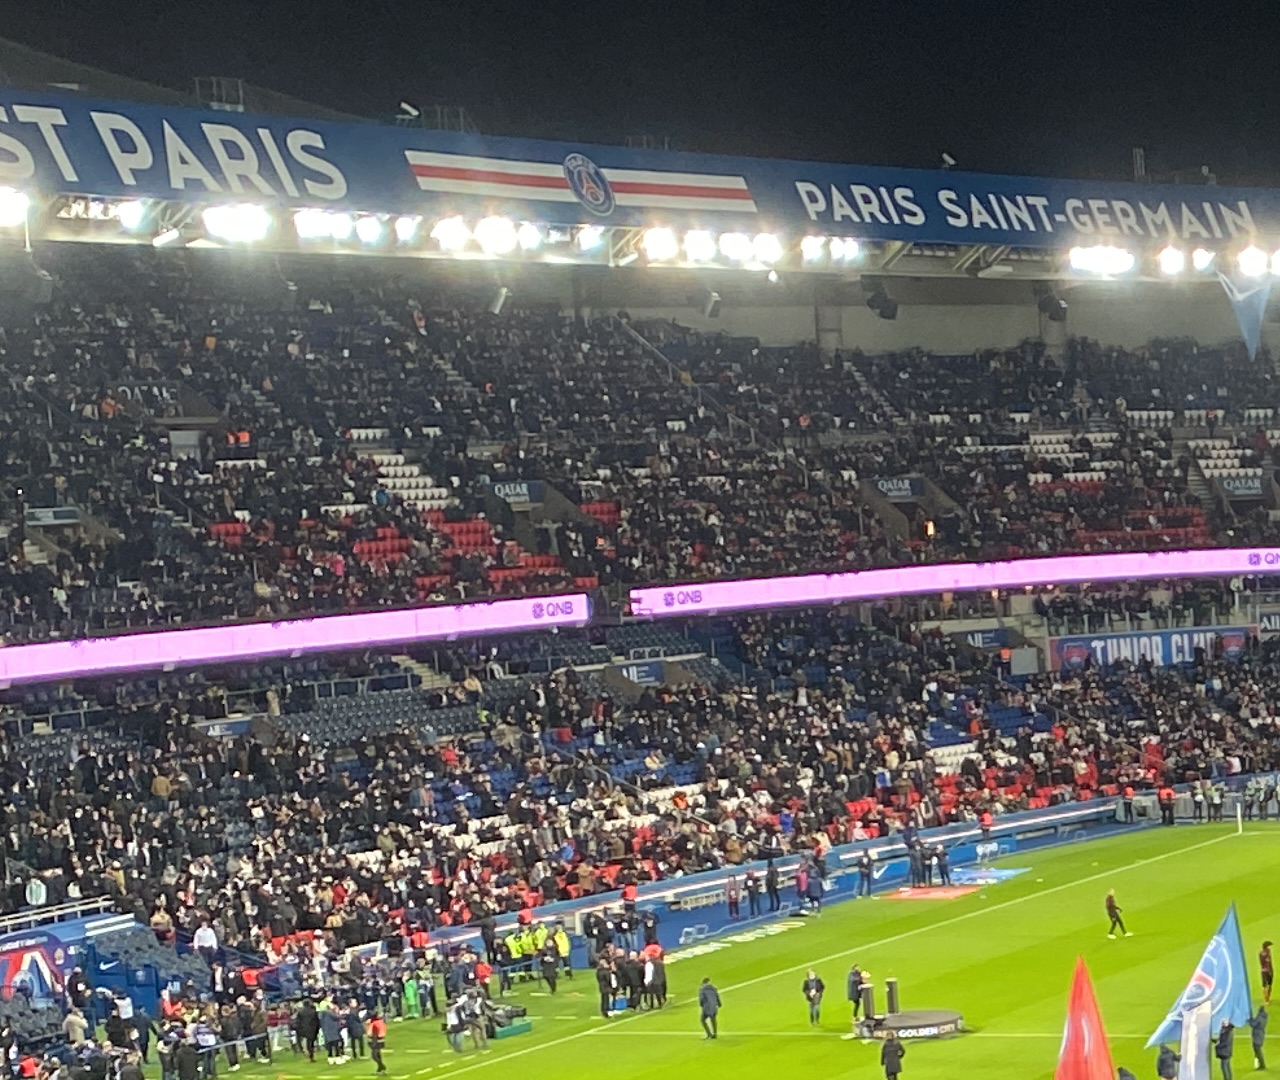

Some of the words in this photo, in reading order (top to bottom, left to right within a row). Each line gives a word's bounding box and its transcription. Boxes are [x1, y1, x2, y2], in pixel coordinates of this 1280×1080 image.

[90, 111, 348, 200] PARIS
[795, 181, 926, 226] PARIS
[937, 189, 1255, 240] SAINT-GERMAIN
[877, 479, 911, 494] QATAR
[1223, 479, 1262, 491] QATAR
[676, 590, 702, 605] QNB
[547, 601, 573, 617] QNB
